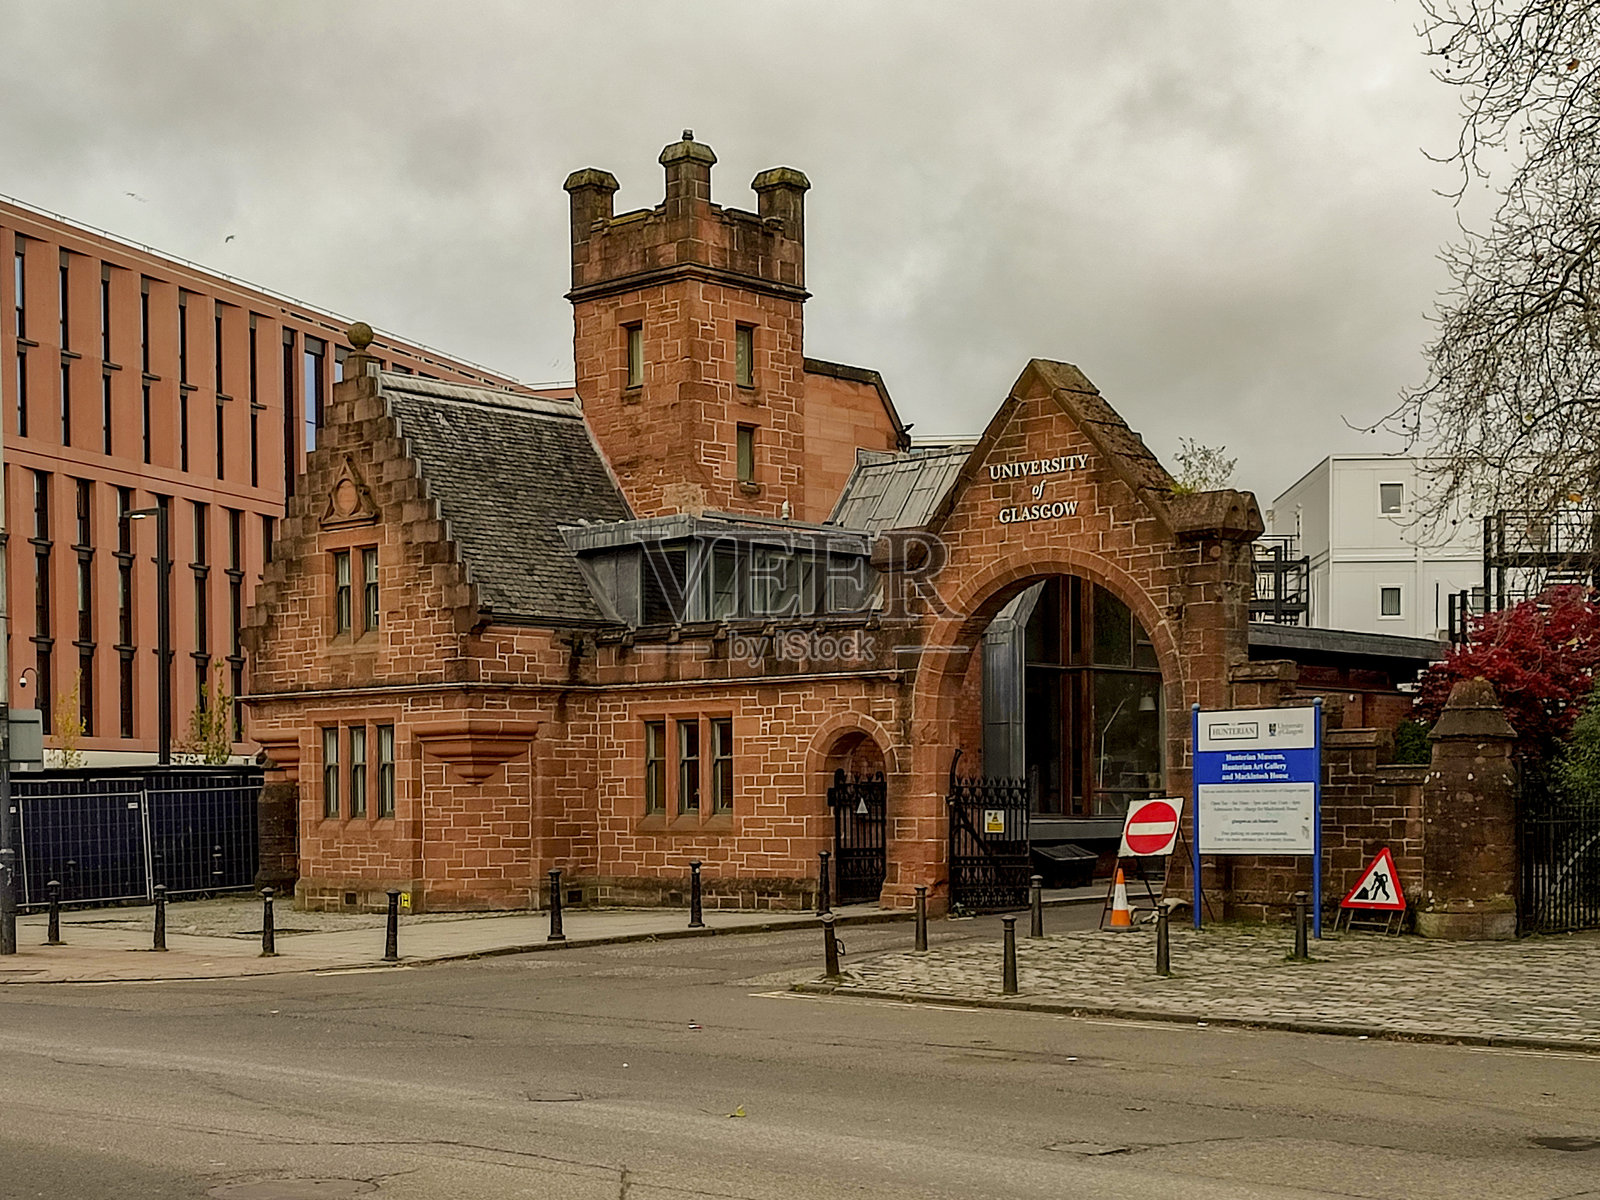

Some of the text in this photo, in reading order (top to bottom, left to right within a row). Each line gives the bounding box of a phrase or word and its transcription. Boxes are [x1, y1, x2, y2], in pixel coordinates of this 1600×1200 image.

[989, 453, 1089, 480] UNIVERSITY
[1032, 479, 1047, 500] of
[999, 501, 1078, 524] GLASGOW
[1212, 727, 1255, 736] HUNTERIAN
[1225, 753, 1256, 761] Hunterian
[1222, 763, 1252, 771] Hunterian
[1264, 762, 1287, 771] Gallery
[1234, 772, 1269, 780] Mackintosh
